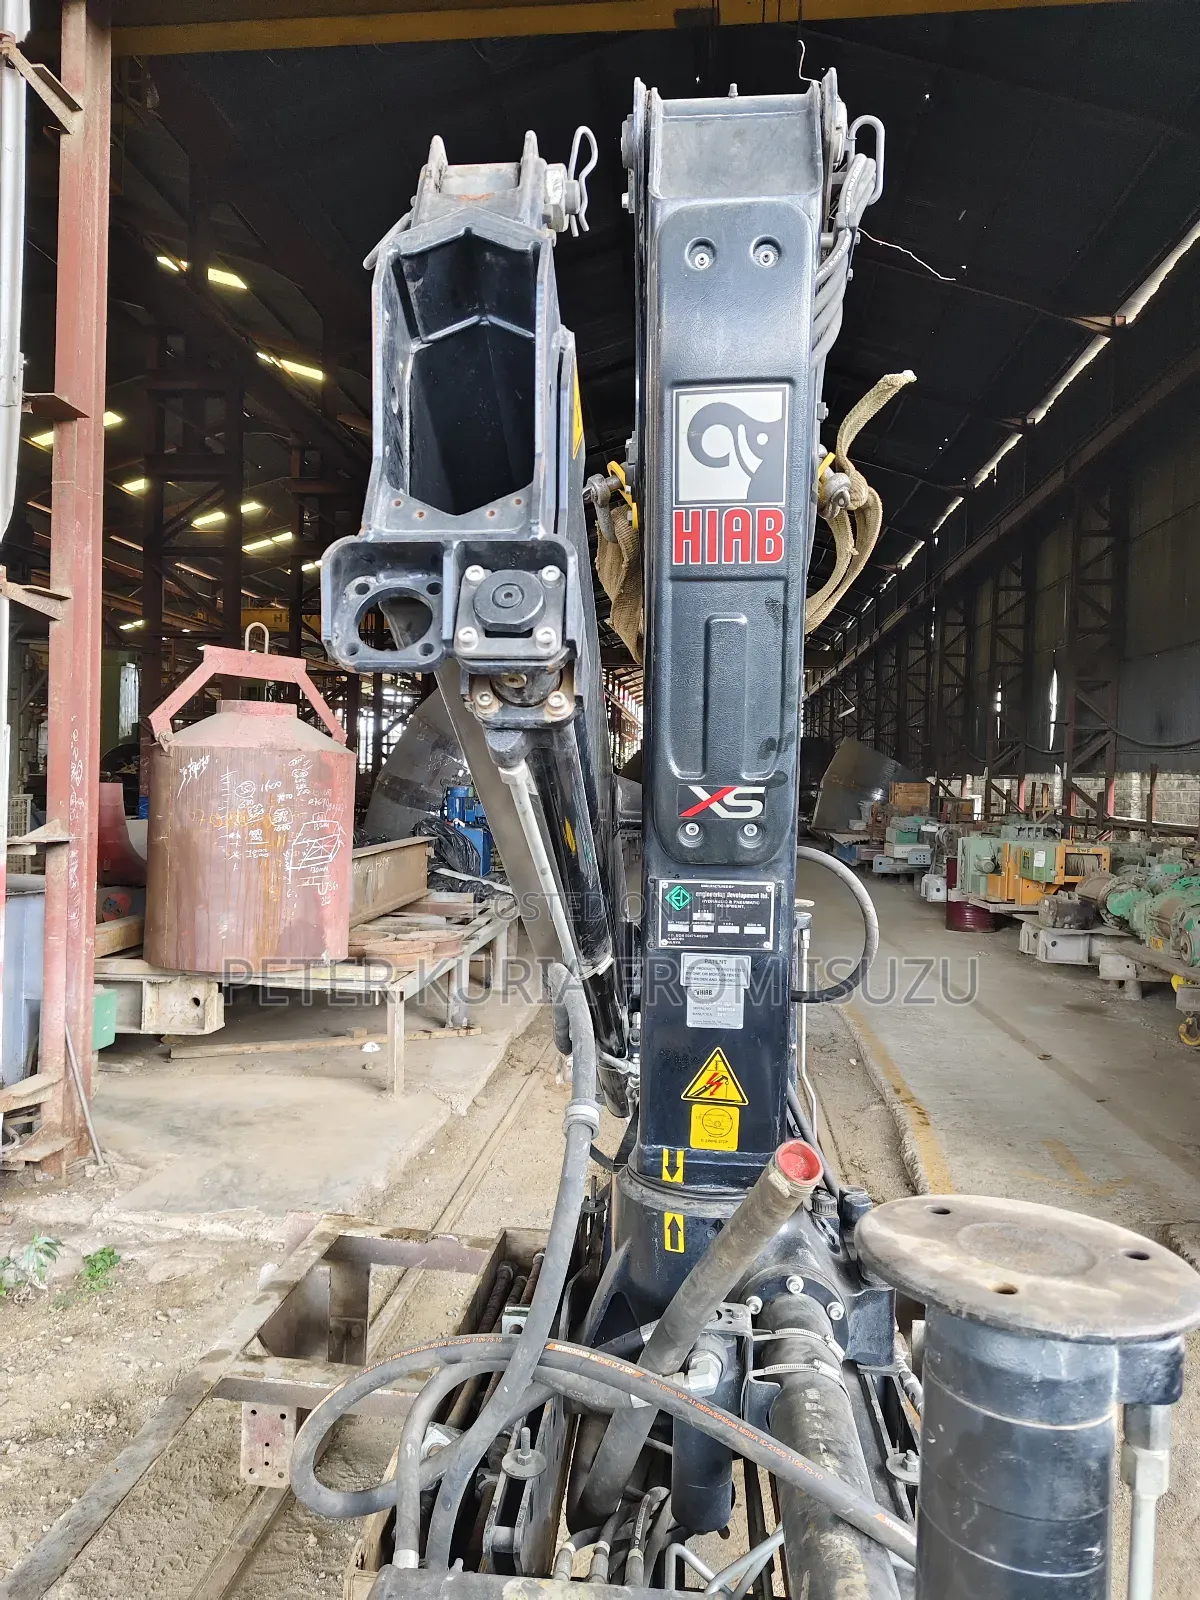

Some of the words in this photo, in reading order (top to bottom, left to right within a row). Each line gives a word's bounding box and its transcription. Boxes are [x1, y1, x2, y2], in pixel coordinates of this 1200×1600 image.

[672, 507, 785, 565] HIAB
[679, 786, 766, 818] XS
[726, 892, 760, 900] development
[738, 1425, 759, 1442] MSHA
